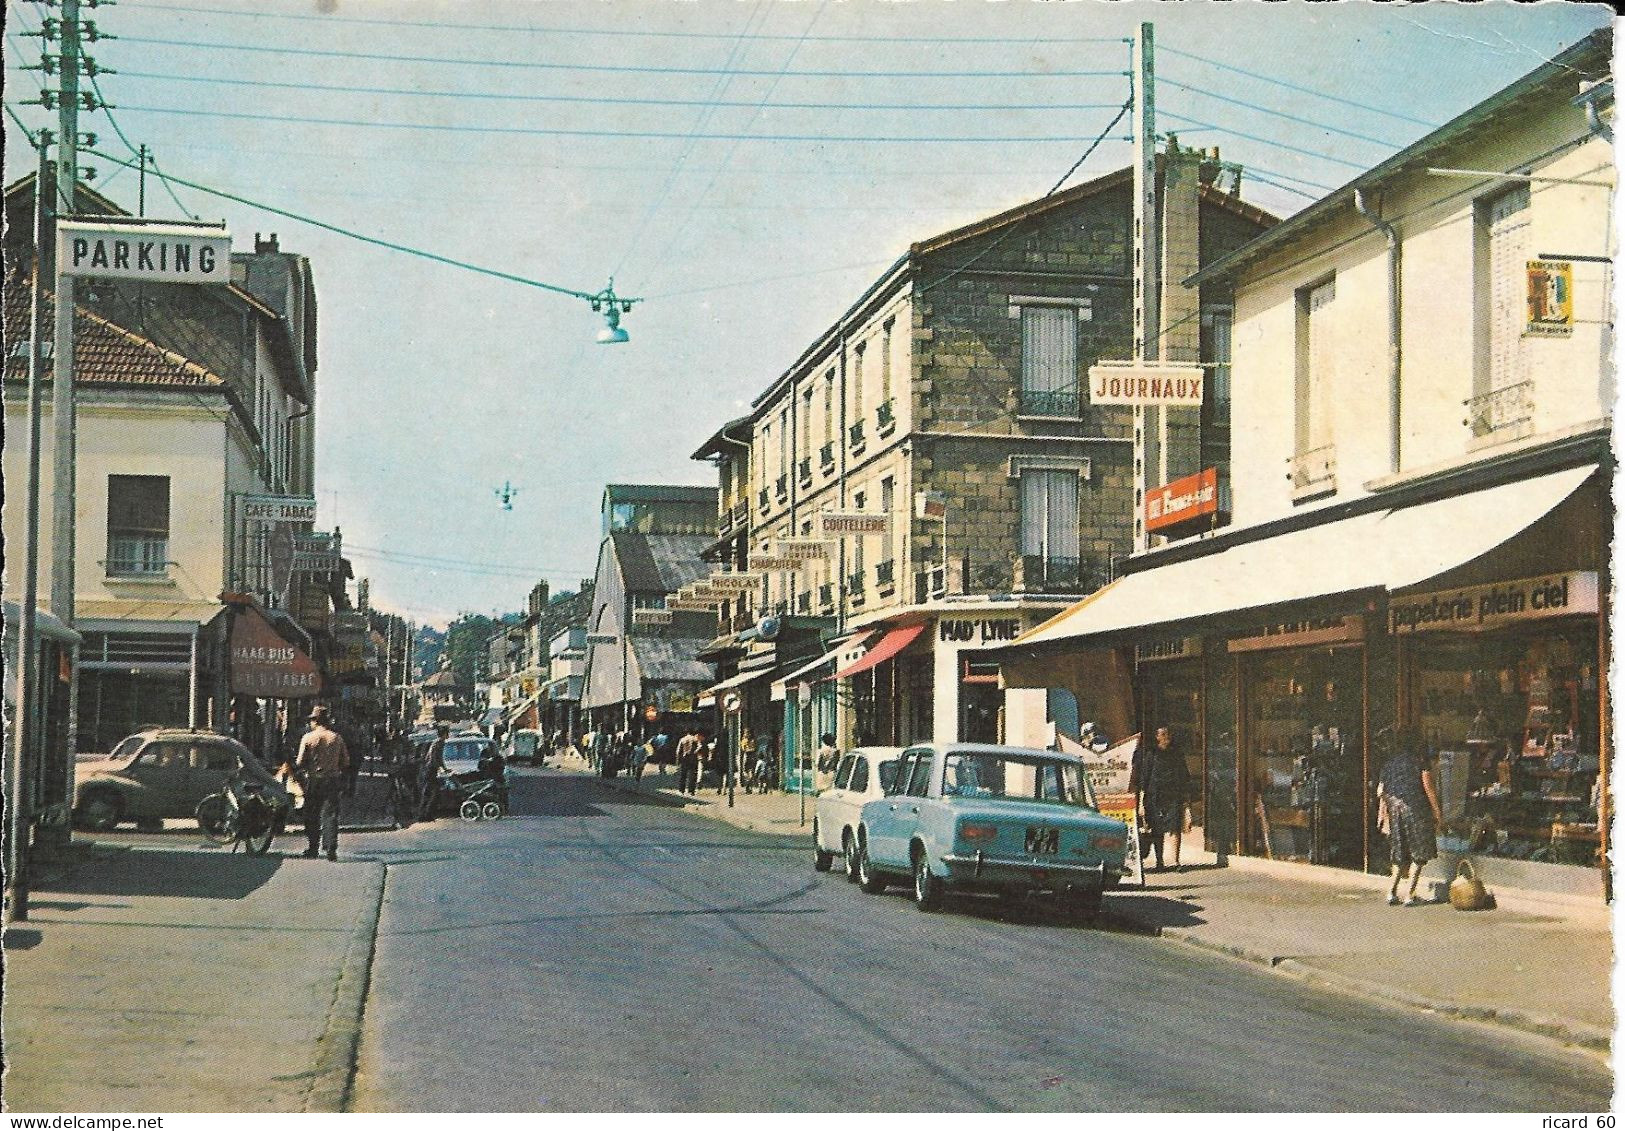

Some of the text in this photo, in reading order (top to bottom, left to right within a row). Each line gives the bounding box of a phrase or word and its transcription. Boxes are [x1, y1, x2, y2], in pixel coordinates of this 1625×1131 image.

[72, 237, 216, 274] PARKING
[1096, 378, 1200, 399] JOURNAUX
[823, 519, 887, 532] COUTELLERIE
[789, 542, 823, 551] POMPES
[750, 559, 803, 570] CHARCUTERIE
[712, 578, 760, 588] NICOLAS
[1394, 576, 1569, 632] papeterie plein ciel
